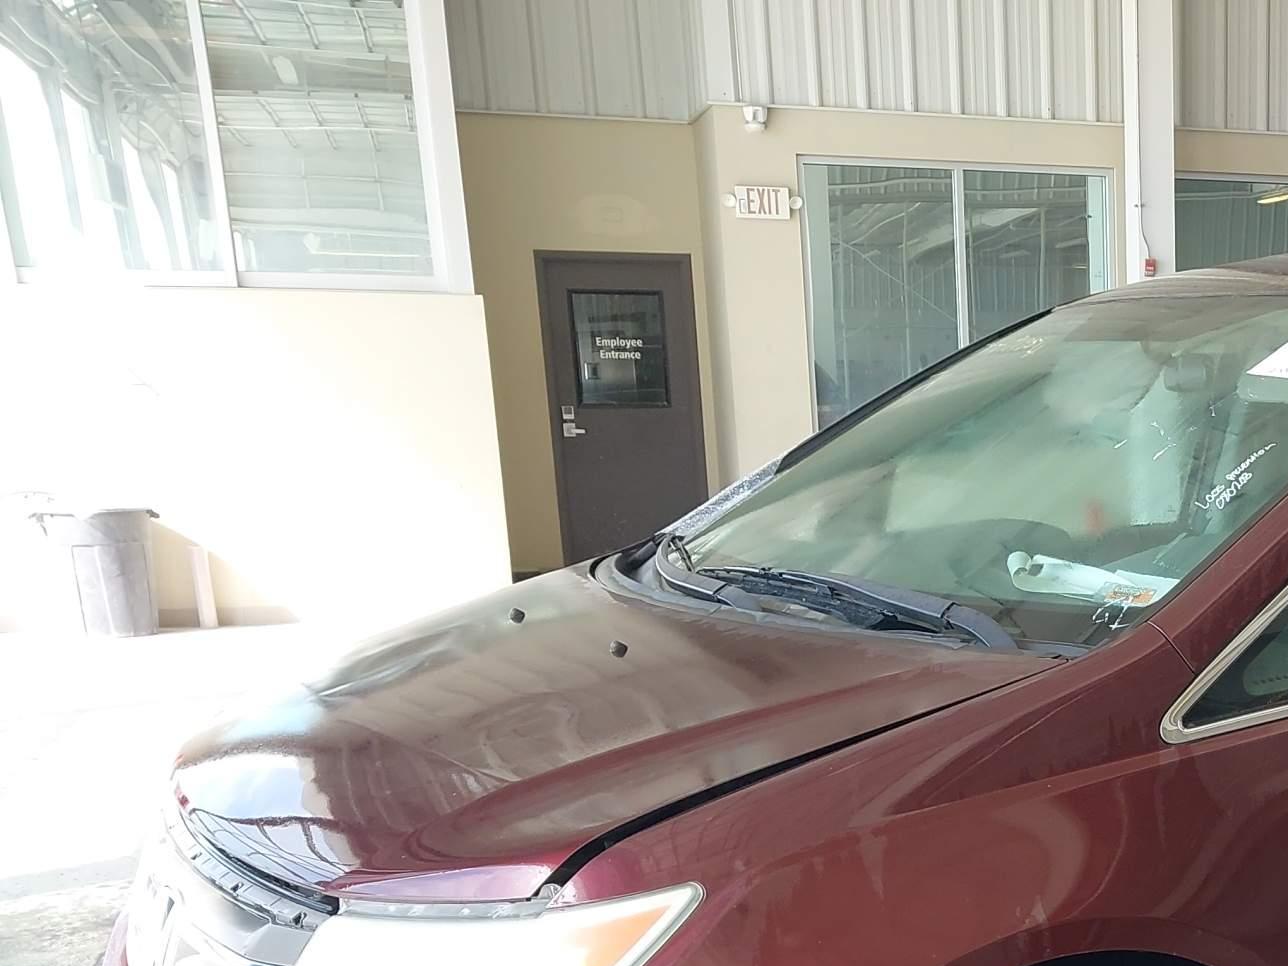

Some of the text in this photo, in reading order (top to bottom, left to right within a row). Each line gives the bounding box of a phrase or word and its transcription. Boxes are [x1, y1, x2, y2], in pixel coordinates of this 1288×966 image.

[746, 187, 780, 215] EXIT
[595, 336, 643, 349] Employee
[600, 350, 641, 360] Entrance
